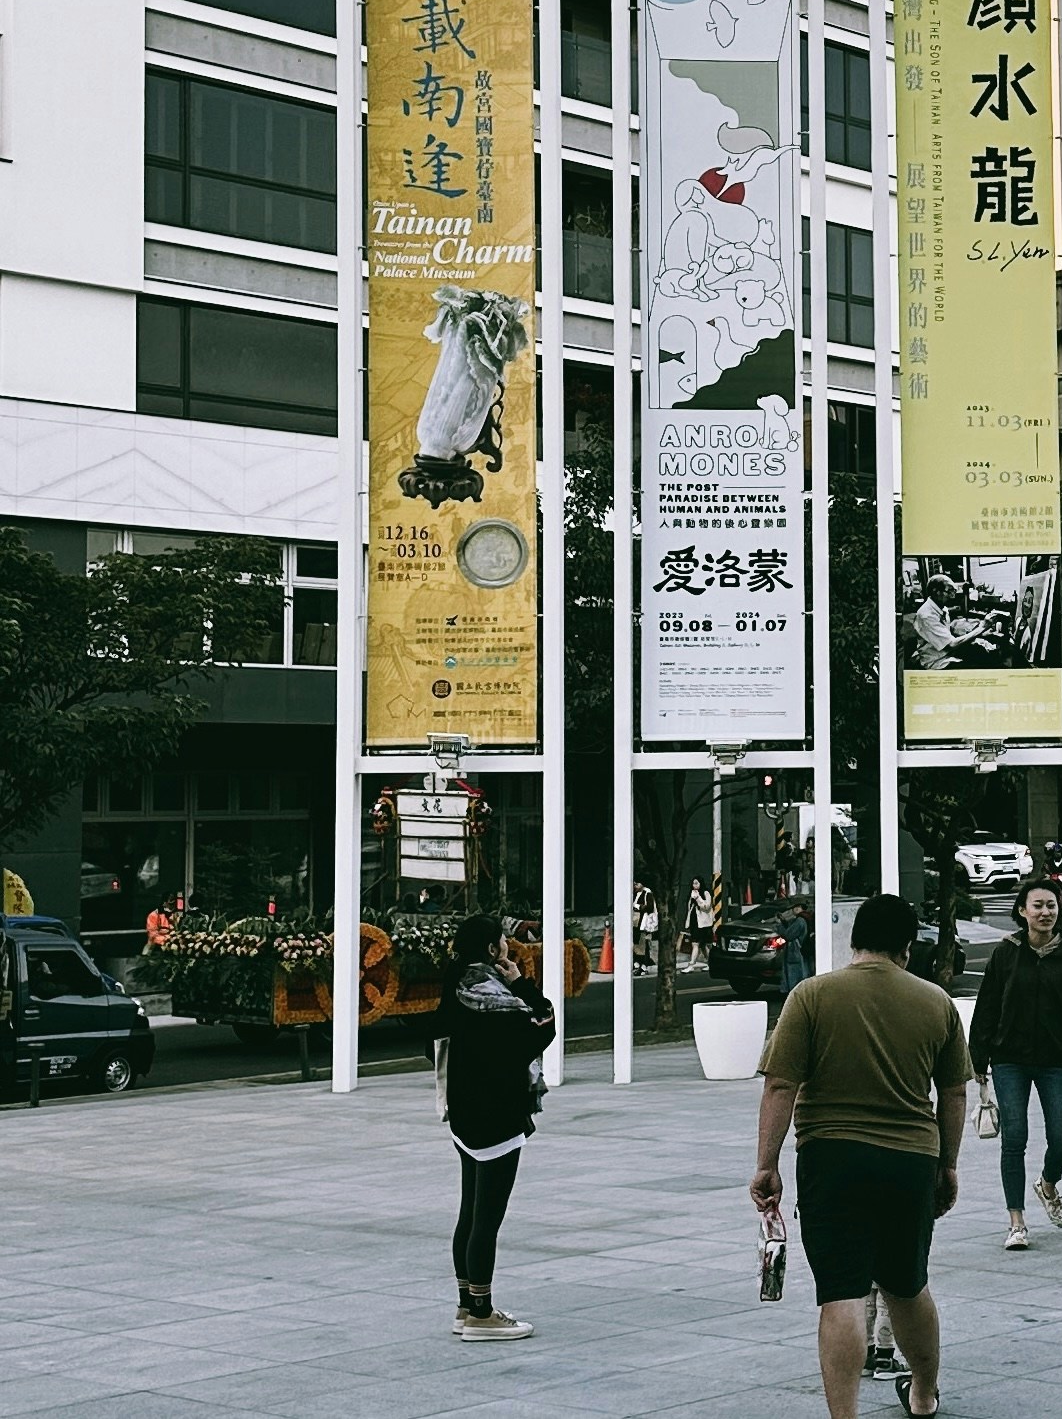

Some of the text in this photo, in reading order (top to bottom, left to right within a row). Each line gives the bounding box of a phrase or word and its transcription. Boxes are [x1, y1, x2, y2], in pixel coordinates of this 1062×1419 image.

[930, 20, 940, 39] THE
[930, 45, 941, 66] SON
[930, 70, 940, 83] OF
[931, 88, 942, 125] TAINAN
[932, 134, 943, 159] ARTS
[932, 164, 943, 191] FROM
[372, 207, 472, 235] Tainan
[933, 196, 944, 233] TAIWAN
[432, 237, 533, 264] Charm
[934, 238, 944, 257] FOR
[373, 251, 431, 265] National
[374, 265, 476, 279] Palace Museum
[906, 162, 929, 399] 展望世界的藝術
[934, 263, 944, 281] THE
[934, 286, 946, 322] WORLD
[966, 415, 1022, 431] 11.03
[659, 424, 758, 448] ANRO
[659, 452, 786, 476] MONES
[659, 483, 720, 491] THE POST
[966, 471, 1023, 488] 03.03
[659, 494, 779, 502] PARADISE BETWEEN
[659, 505, 787, 513] HUMAN AND ANIMALS
[653, 545, 793, 595] 愛洛蒙
[659, 619, 787, 632] 09.08 01.07
